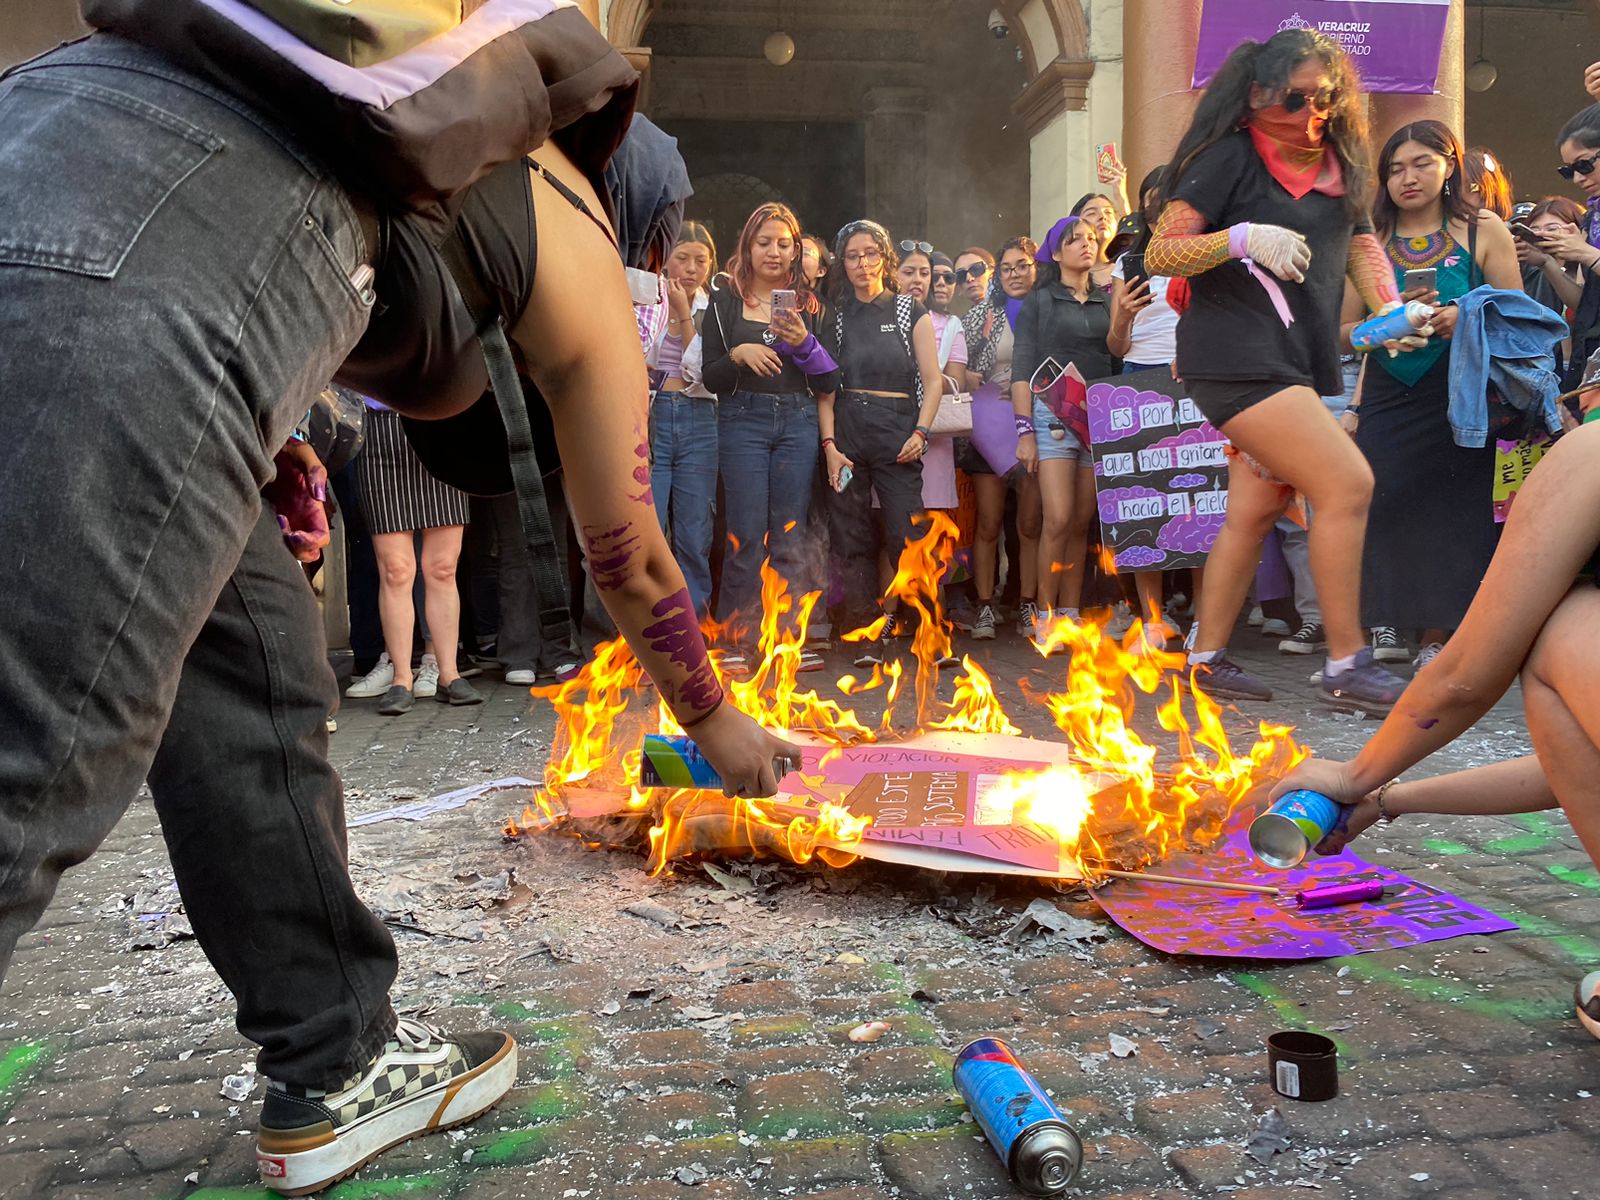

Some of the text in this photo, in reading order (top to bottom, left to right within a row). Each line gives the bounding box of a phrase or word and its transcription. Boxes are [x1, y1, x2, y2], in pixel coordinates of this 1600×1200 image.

[1317, 21, 1371, 33] VERACRUZ
[1340, 45, 1371, 55] STADO
[1112, 409, 1132, 427] ES
[1105, 443, 1226, 474] que hoy gritam
[1121, 499, 1160, 517] hacia
[1170, 494, 1187, 514] el
[867, 829, 963, 846] FEMIN
